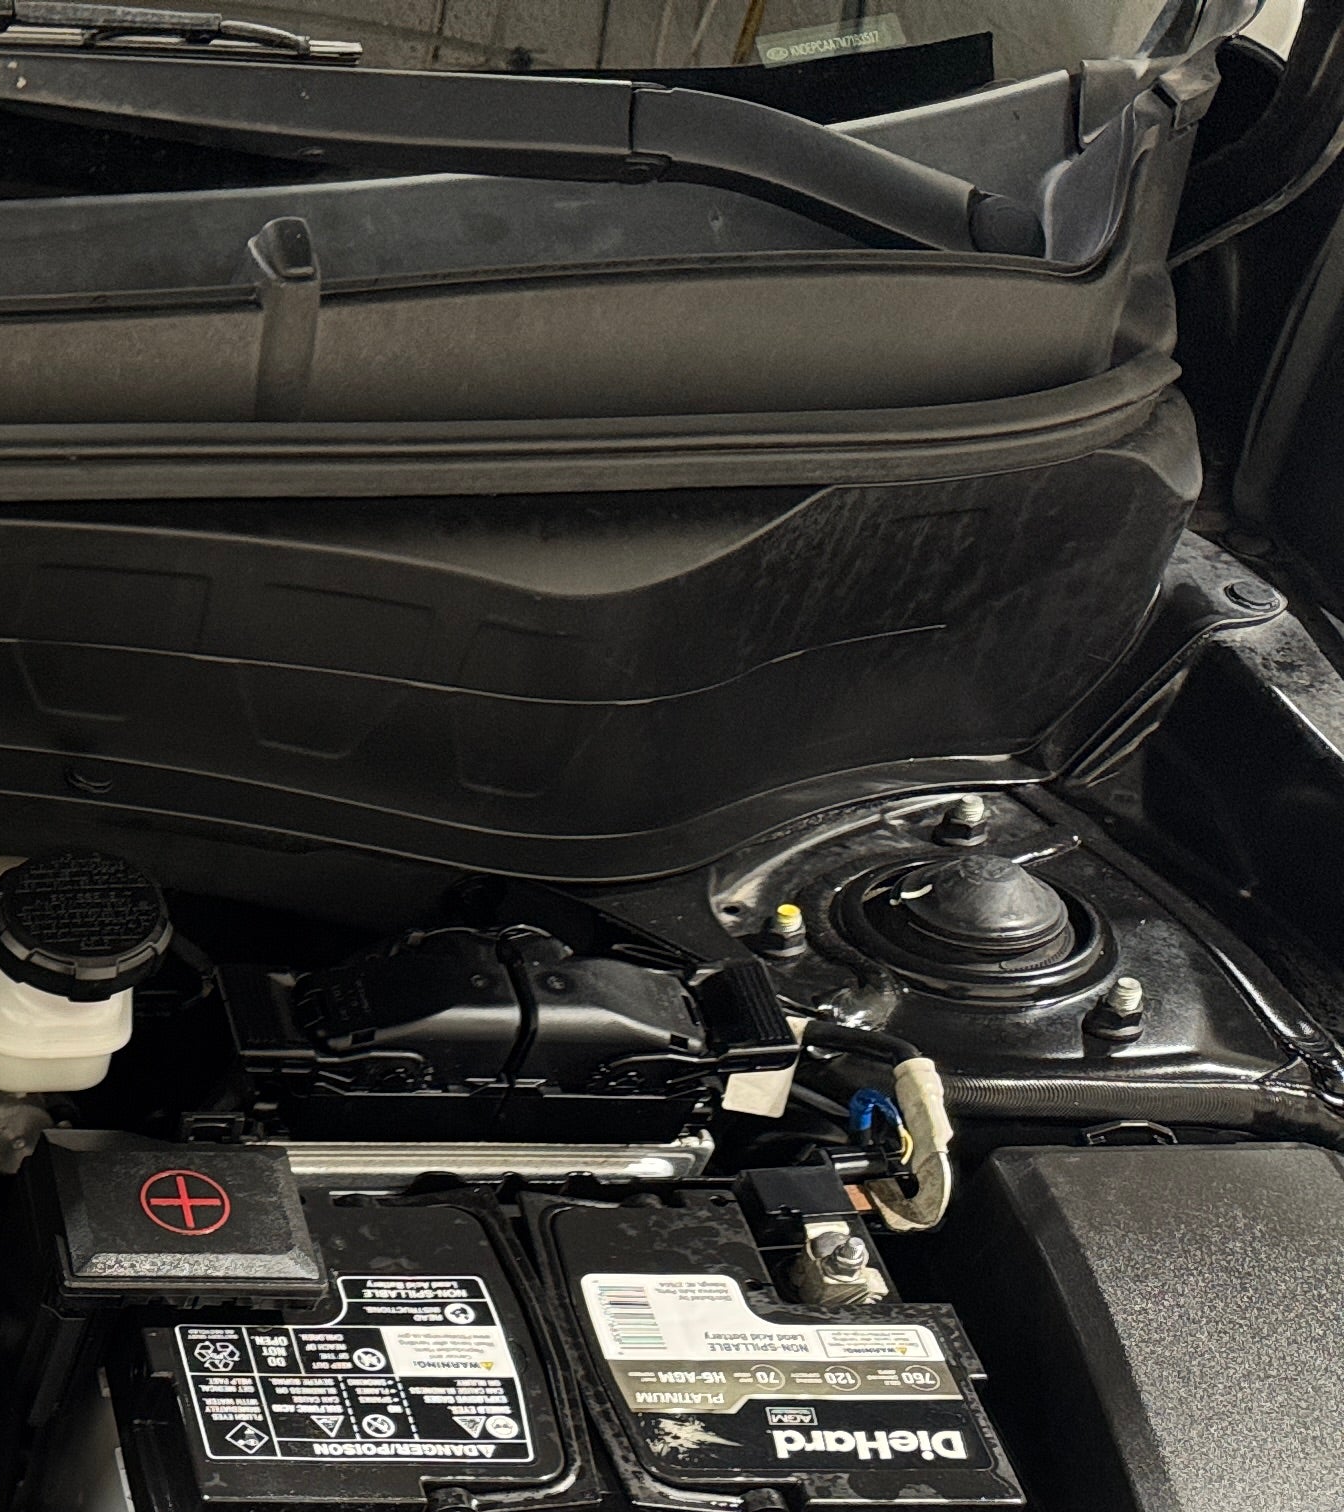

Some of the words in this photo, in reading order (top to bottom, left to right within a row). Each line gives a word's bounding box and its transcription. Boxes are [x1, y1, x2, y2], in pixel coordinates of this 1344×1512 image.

[405, 1280, 430, 1289] Acid
[431, 1280, 459, 1289] Lead
[361, 1288, 468, 1298] NON-SPILLABLE
[250, 1336, 289, 1346] OPEN.
[705, 1332, 747, 1342] Battery
[750, 1334, 774, 1342] Acid
[776, 1334, 805, 1342] Lead
[261, 1346, 288, 1356] NOT
[706, 1343, 810, 1352] NON-SPILLABLE
[267, 1356, 287, 1367] DO
[413, 1361, 481, 1369] WARNING:
[657, 1371, 727, 1384] H6-AGM
[755, 1371, 780, 1383] 70
[823, 1372, 856, 1384] 120
[901, 1372, 937, 1384] 760
[635, 1392, 725, 1404] PLATINUM
[771, 1413, 812, 1423] AGM
[313, 1443, 480, 1457] DANGER/POISON
[772, 1429, 968, 1461] DieHard
